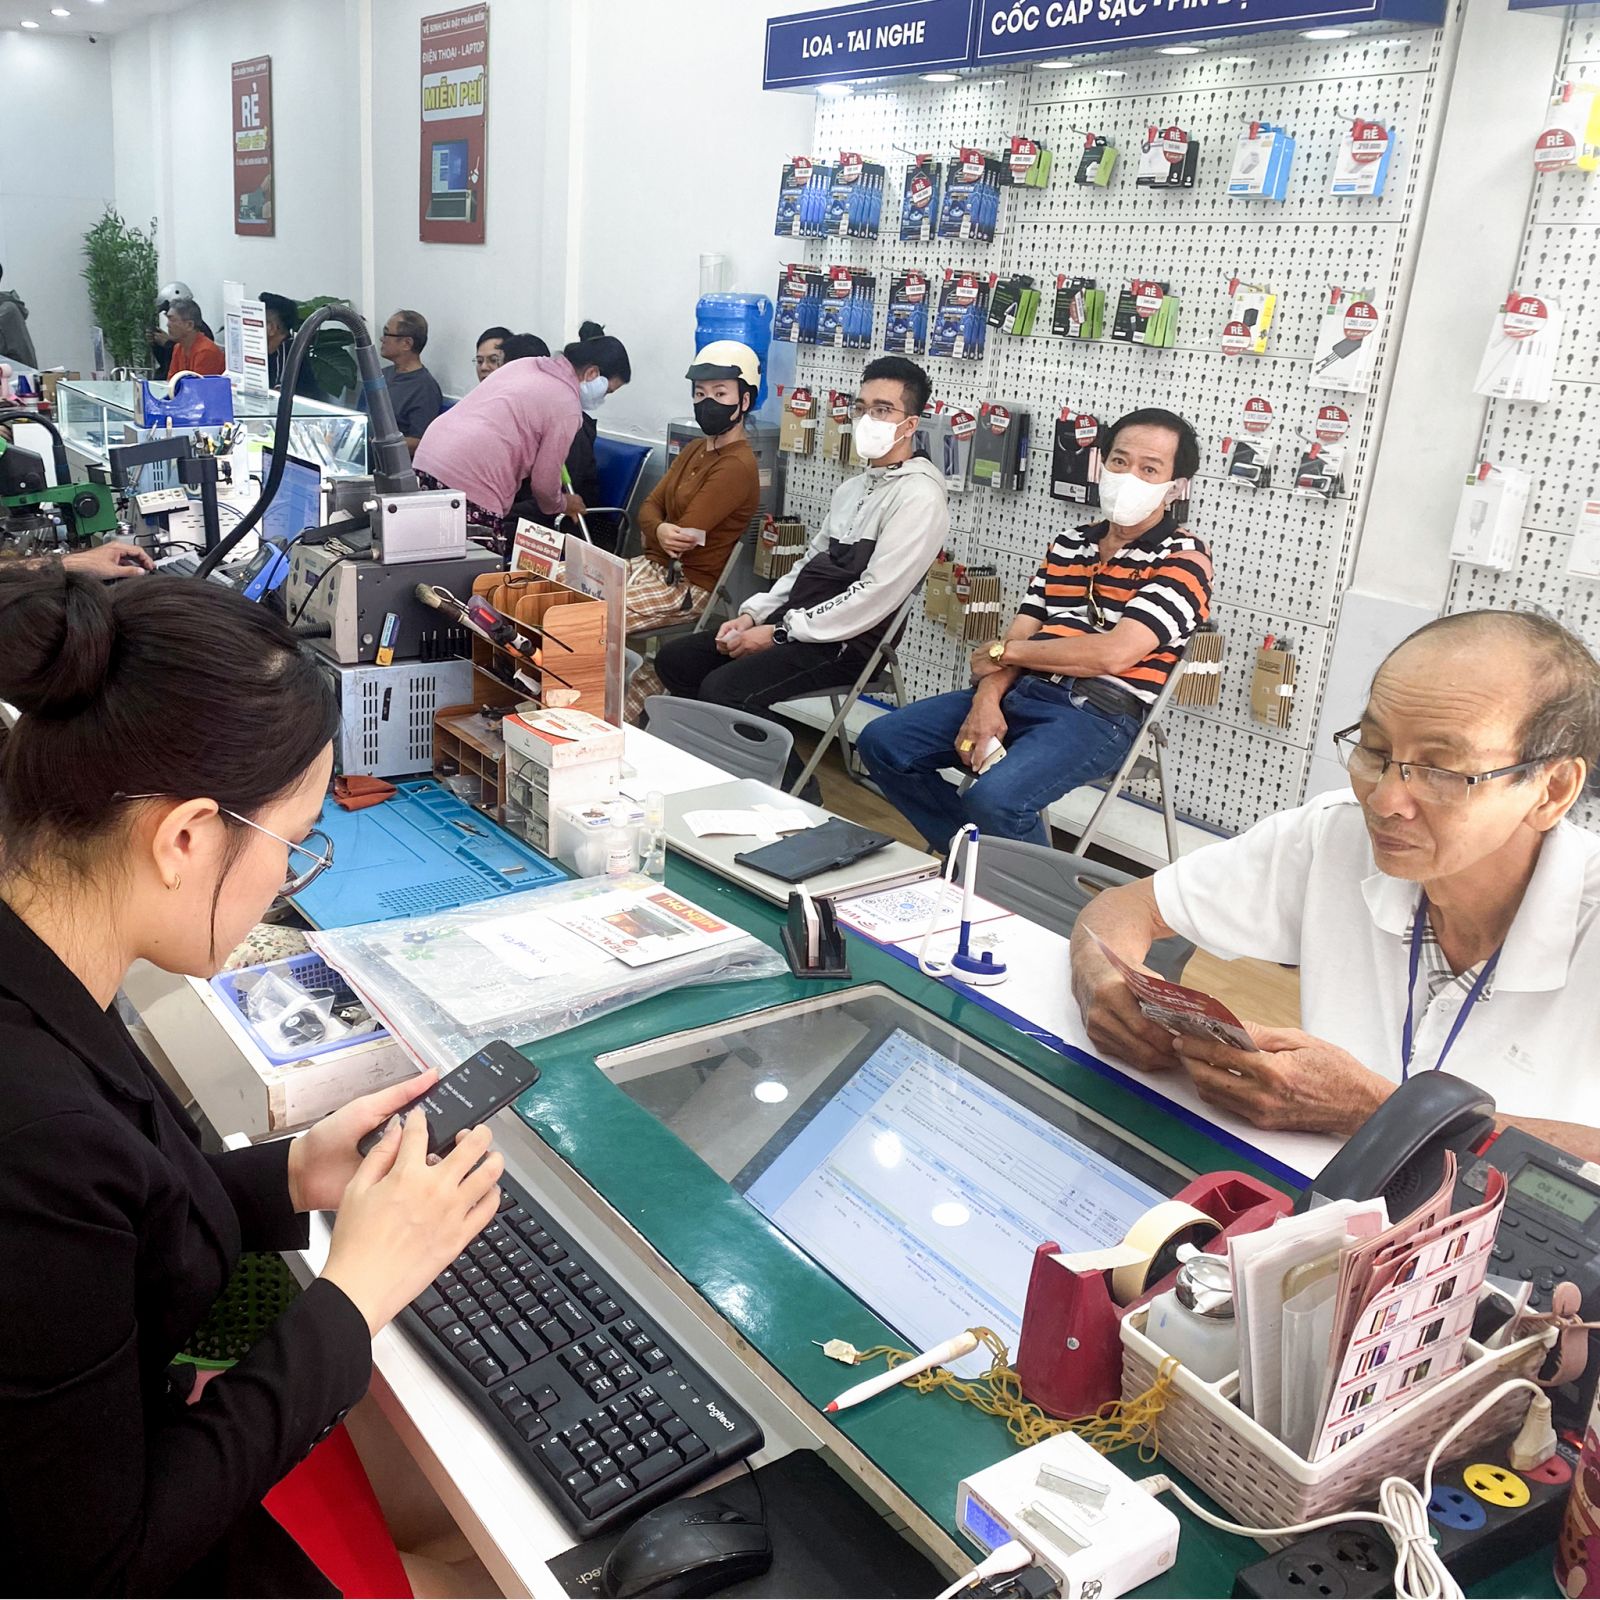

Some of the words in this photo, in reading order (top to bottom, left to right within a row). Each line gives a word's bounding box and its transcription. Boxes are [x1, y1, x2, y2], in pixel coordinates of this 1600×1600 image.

[802, 37, 833, 58] LOA
[847, 28, 871, 53] TAI
[875, 21, 926, 49] NGHE
[422, 49, 438, 64] ĐIỆN
[438, 47, 457, 61] THOẠI
[462, 41, 485, 56] LAPTOP
[424, 76, 457, 111] MIỄN
[460, 72, 484, 107] PHÍ
[241, 82, 260, 128] RẺ
[1170, 129, 1181, 140] RẺ
[1364, 126, 1379, 140] RẺ
[1546, 131, 1565, 146] RẺ
[1019, 143, 1030, 154] RẺ
[963, 277, 973, 287] RẺ
[1145, 284, 1157, 296] RẺ
[1355, 304, 1370, 317] RẺ
[1519, 300, 1539, 314] RẺ
[1231, 324, 1244, 335] RẺ
[1252, 400, 1265, 412] RẺ
[956, 415, 969, 424] RẺ
[1326, 408, 1340, 419] RẺ
[1080, 418, 1091, 428] RẺ
[706, 1402, 735, 1432] logitech
